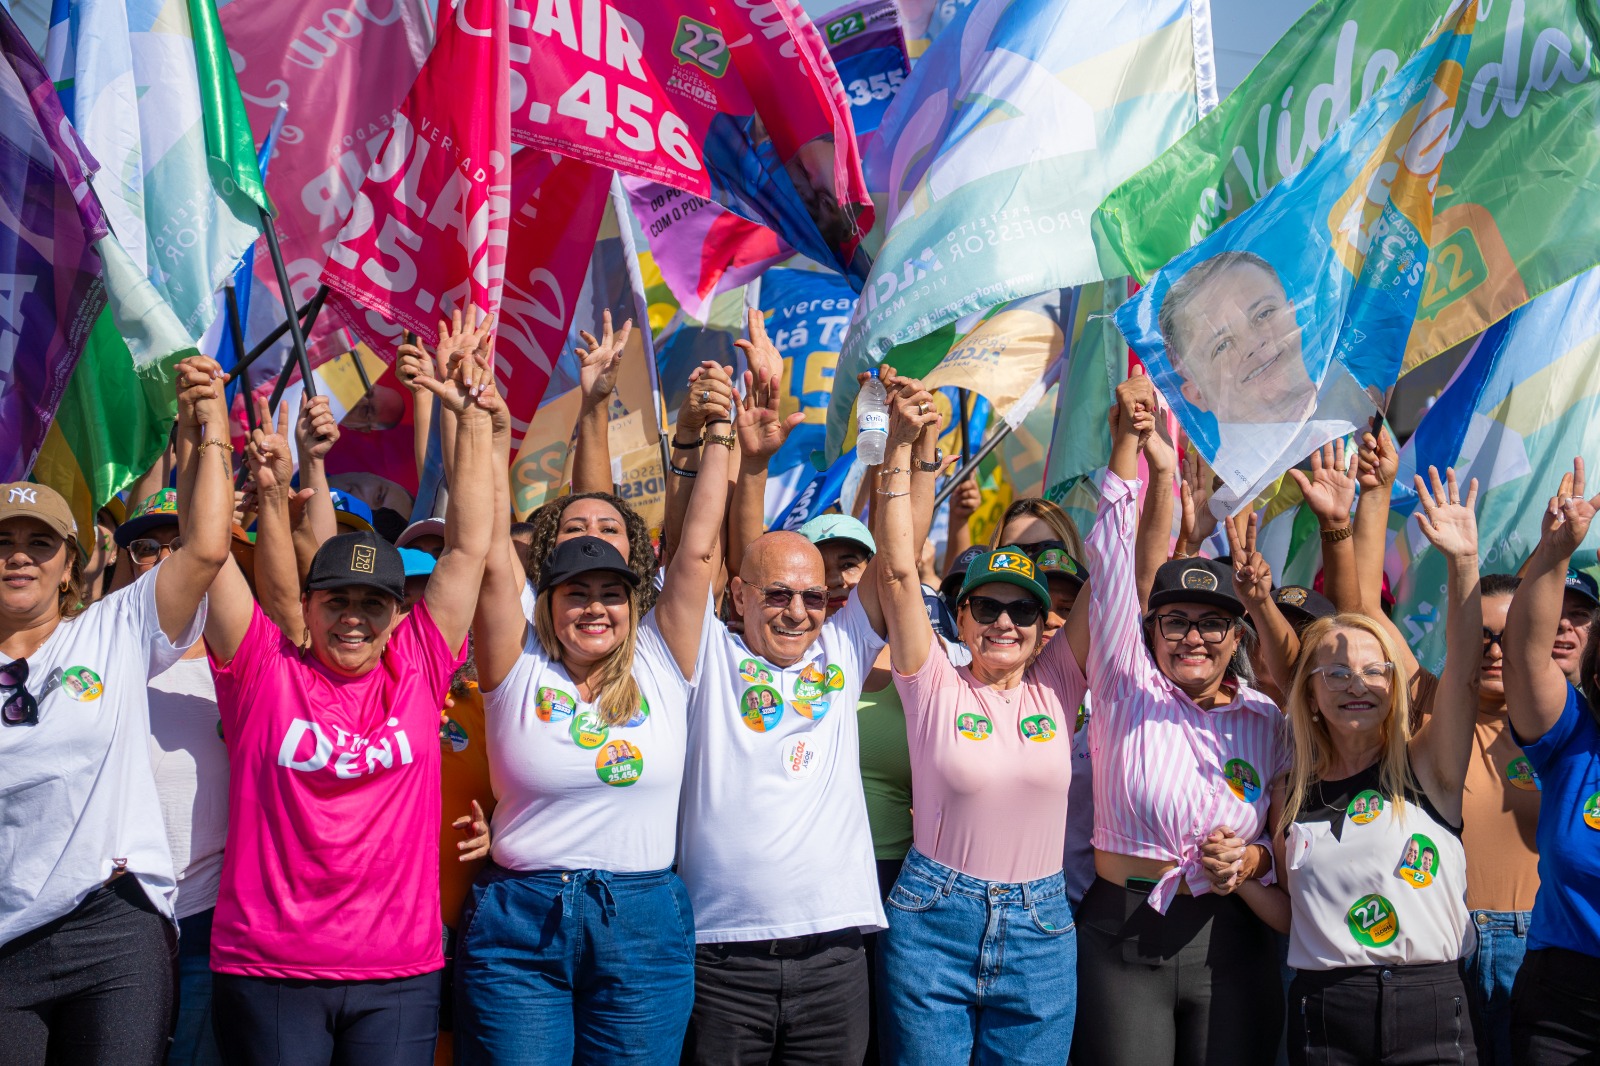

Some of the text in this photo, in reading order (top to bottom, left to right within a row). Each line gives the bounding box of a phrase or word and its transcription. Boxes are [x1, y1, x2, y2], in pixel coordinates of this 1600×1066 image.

[508, 0, 648, 82] LAIR
[831, 16, 859, 41] 22
[680, 23, 726, 70] 22
[667, 75, 718, 105] ALCIDES
[508, 41, 701, 172] 5.456
[421, 116, 490, 192] VEREAD
[651, 191, 666, 212] DO
[649, 210, 671, 239] COM
[672, 206, 682, 227] O
[1422, 244, 1473, 308] 22
[768, 319, 809, 351] tá
[8, 488, 37, 504] NY
[162, 501, 176, 511] 22
[1009, 555, 1031, 576] 22
[792, 740, 806, 771] 70700
[802, 750, 811, 769] ROSY
[608, 769, 638, 782] 25.456
[1414, 872, 1425, 883] 22
[1354, 900, 1387, 929] 22
